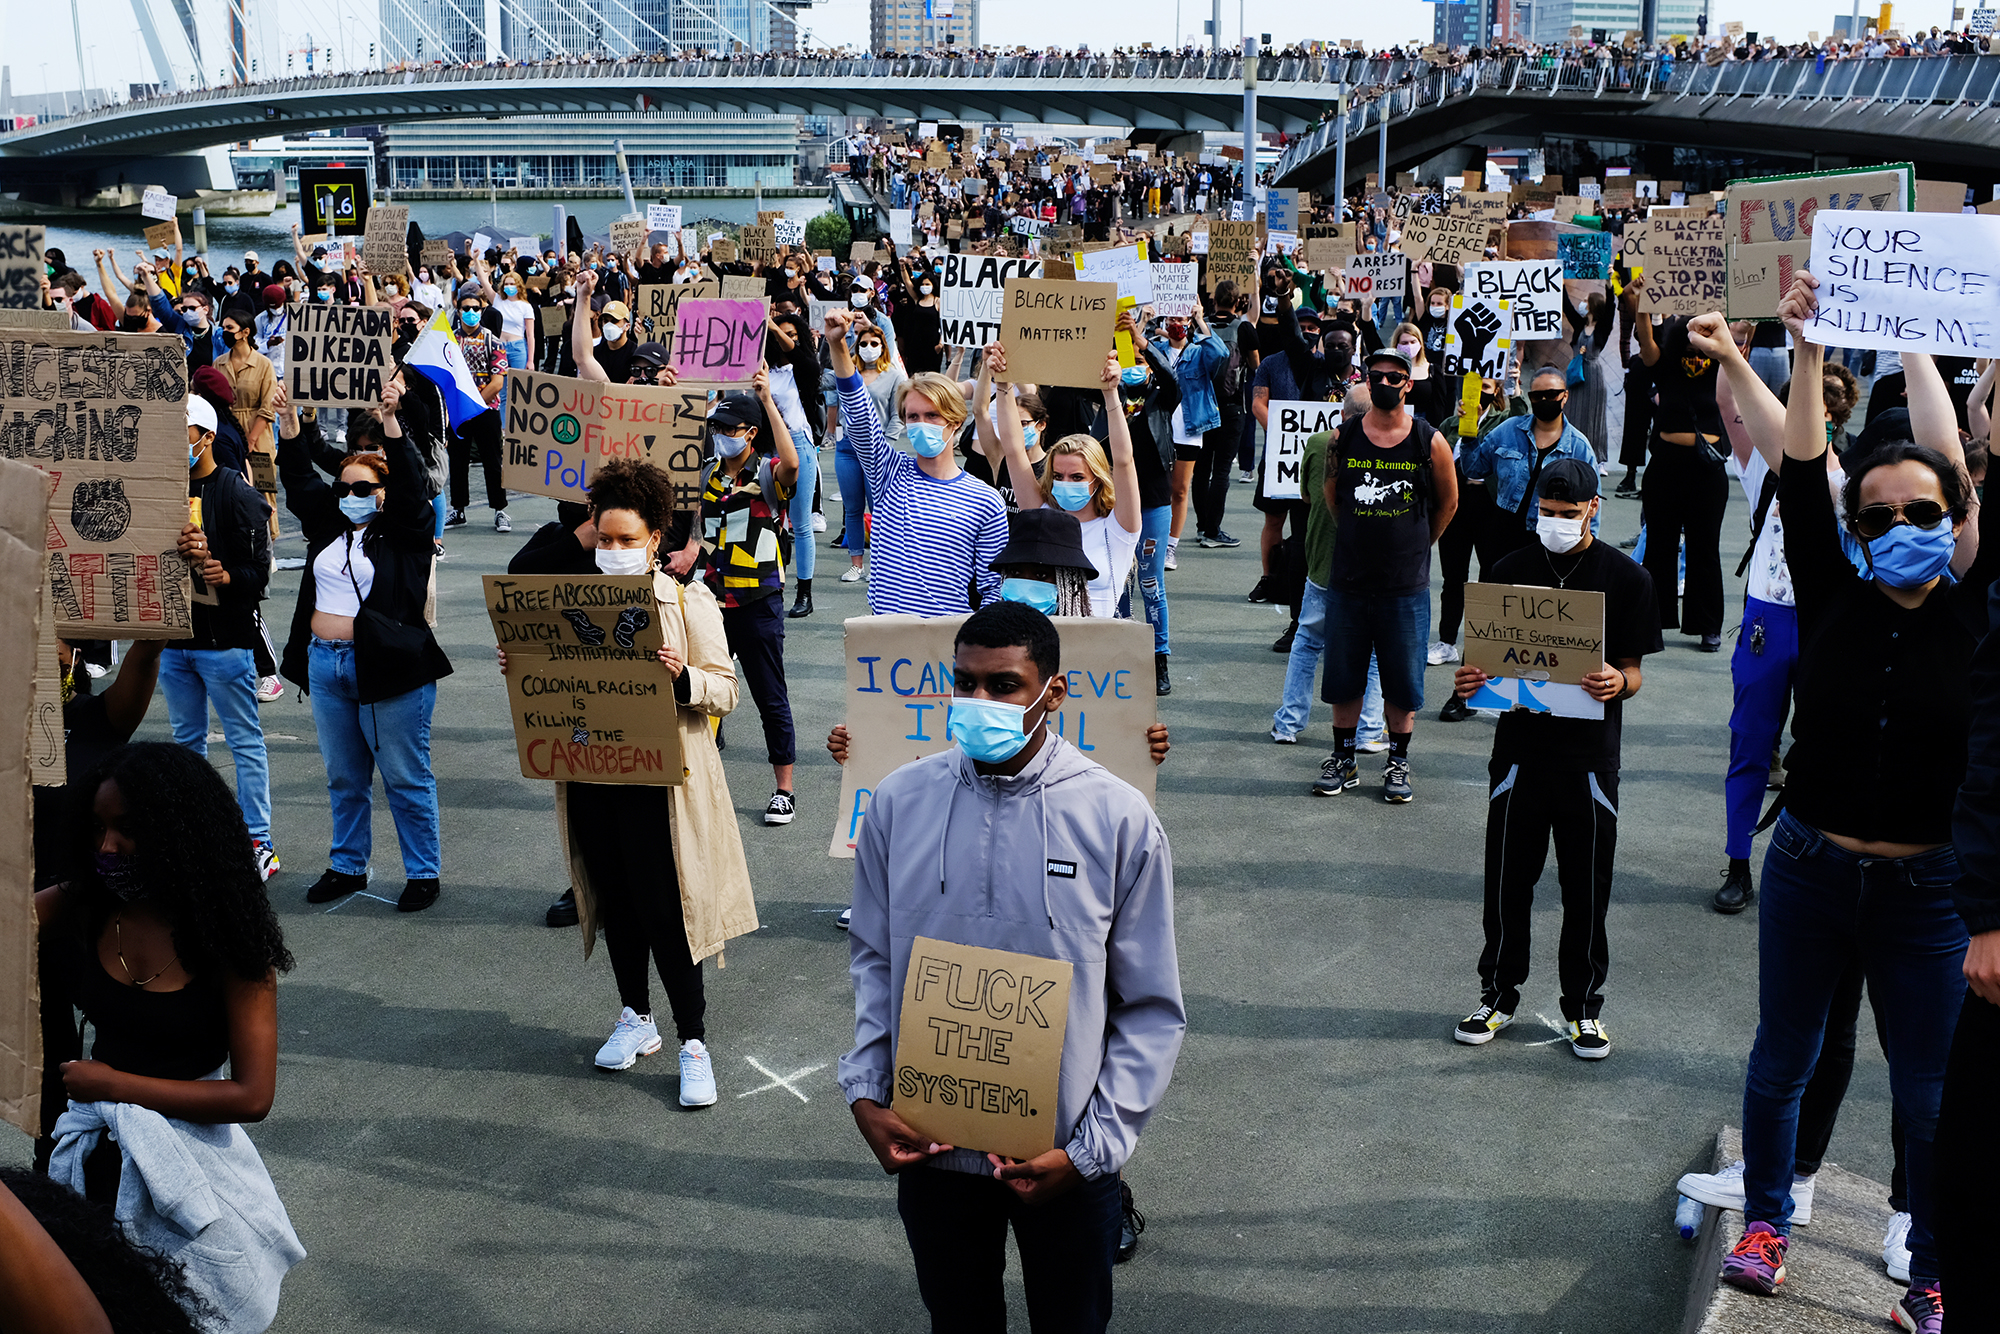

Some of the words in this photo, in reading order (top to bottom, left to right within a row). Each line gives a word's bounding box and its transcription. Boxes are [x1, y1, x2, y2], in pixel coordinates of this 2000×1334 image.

[382, 209, 396, 220] YOU
[396, 208, 408, 220] ARE
[368, 221, 398, 231] NEUTRAL
[400, 222, 407, 231] IN
[614, 221, 640, 230] SILENCE
[744, 228, 766, 238] BLACK
[774, 223, 802, 233] POWER
[1210, 224, 1234, 236] WHO
[1240, 223, 1253, 236] DO
[1410, 215, 1429, 228] NO
[1432, 218, 1484, 234] JUSTICE
[1655, 220, 1709, 232] BLACK
[0, 228, 42, 260] ACK
[366, 232, 404, 243] SITUATIONS
[612, 232, 642, 240] BETRAYAL
[744, 238, 764, 247] LIVES
[776, 236, 802, 245] EOPLE
[1209, 239, 1228, 251] YOU
[1228, 239, 1251, 250] CALL
[1406, 230, 1426, 243] NO
[1436, 234, 1484, 252] PEACE
[1560, 235, 1585, 249] WE
[1589, 235, 1608, 250] ALL
[1674, 232, 1723, 241] MATTE
[1823, 222, 1922, 253] YOUR
[366, 243, 376, 251] OF
[743, 248, 776, 262] MATTER
[1424, 247, 1460, 264] ACAB
[1571, 250, 1600, 262] BLEED
[1654, 246, 1698, 257] BLACK
[1700, 246, 1724, 258] TRA
[1208, 251, 1232, 262] WHEN
[1352, 254, 1404, 268] ARREST
[1668, 257, 1703, 267] LIVES
[944, 254, 1042, 288] BLACK
[1152, 264, 1166, 274] NO
[1169, 264, 1191, 274] LIVES
[1208, 264, 1236, 274] ABUSE
[1238, 264, 1254, 274] AND
[1575, 270, 1600, 279] COLOR
[1653, 270, 1707, 284] STOP
[1828, 254, 1990, 294] SILENCE
[1348, 277, 1372, 292] NO
[1376, 277, 1404, 290] REST
[1478, 266, 1562, 293] BLACK
[1015, 290, 1064, 309] BLACK
[1156, 293, 1174, 301] IVES
[1646, 284, 1699, 304] BLACK
[1830, 283, 1858, 302] IS
[942, 290, 1004, 319] LIVE
[1512, 310, 1561, 332] TTER
[1814, 307, 1926, 340] KILLING
[1936, 318, 1992, 349] ME
[942, 319, 1002, 346] MATT
[1020, 326, 1087, 342] MATTER!!
[292, 335, 316, 362] DI
[322, 335, 385, 366] KEDA
[675, 317, 768, 368] #BLM
[293, 367, 384, 402] LUCHA
[511, 376, 559, 408] NO
[509, 406, 548, 434] NO
[1281, 408, 1342, 433] BLAC
[505, 438, 538, 468] THE
[668, 394, 708, 509] #BLM
[1347, 458, 1372, 468] Dead
[1375, 459, 1418, 472] Kennedy
[494, 580, 550, 614] FREE
[608, 586, 651, 606] ISLANDS
[1502, 596, 1574, 622] FUCK
[497, 620, 562, 643] DUTCH
[1530, 630, 1602, 653] SUPREMACY
[1503, 648, 1559, 667] ACAB
[856, 656, 883, 693] I
[592, 730, 625, 742] THE
[526, 738, 663, 777] CARIBBEAN
[1048, 862, 1074, 874] PUMA
[915, 956, 1056, 1028] FUCK
[928, 1017, 1012, 1065] THE
[898, 1066, 1038, 1116] SYSTEM.
